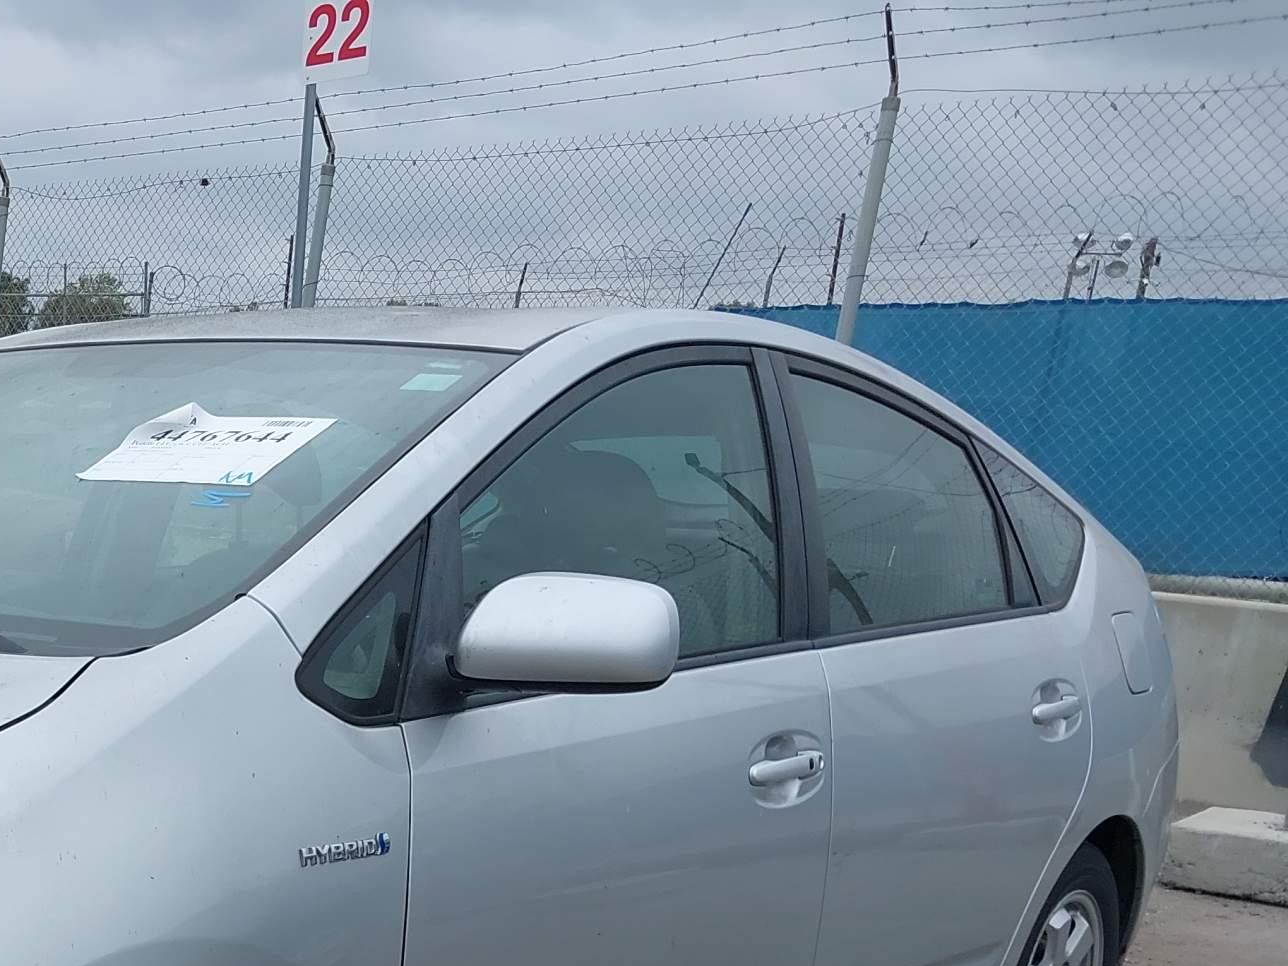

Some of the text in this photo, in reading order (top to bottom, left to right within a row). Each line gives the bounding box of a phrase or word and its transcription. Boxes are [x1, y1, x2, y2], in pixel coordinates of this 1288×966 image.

[305, 0, 370, 67] 22
[150, 429, 293, 443] 44767644
[299, 839, 377, 867] HYBRID
